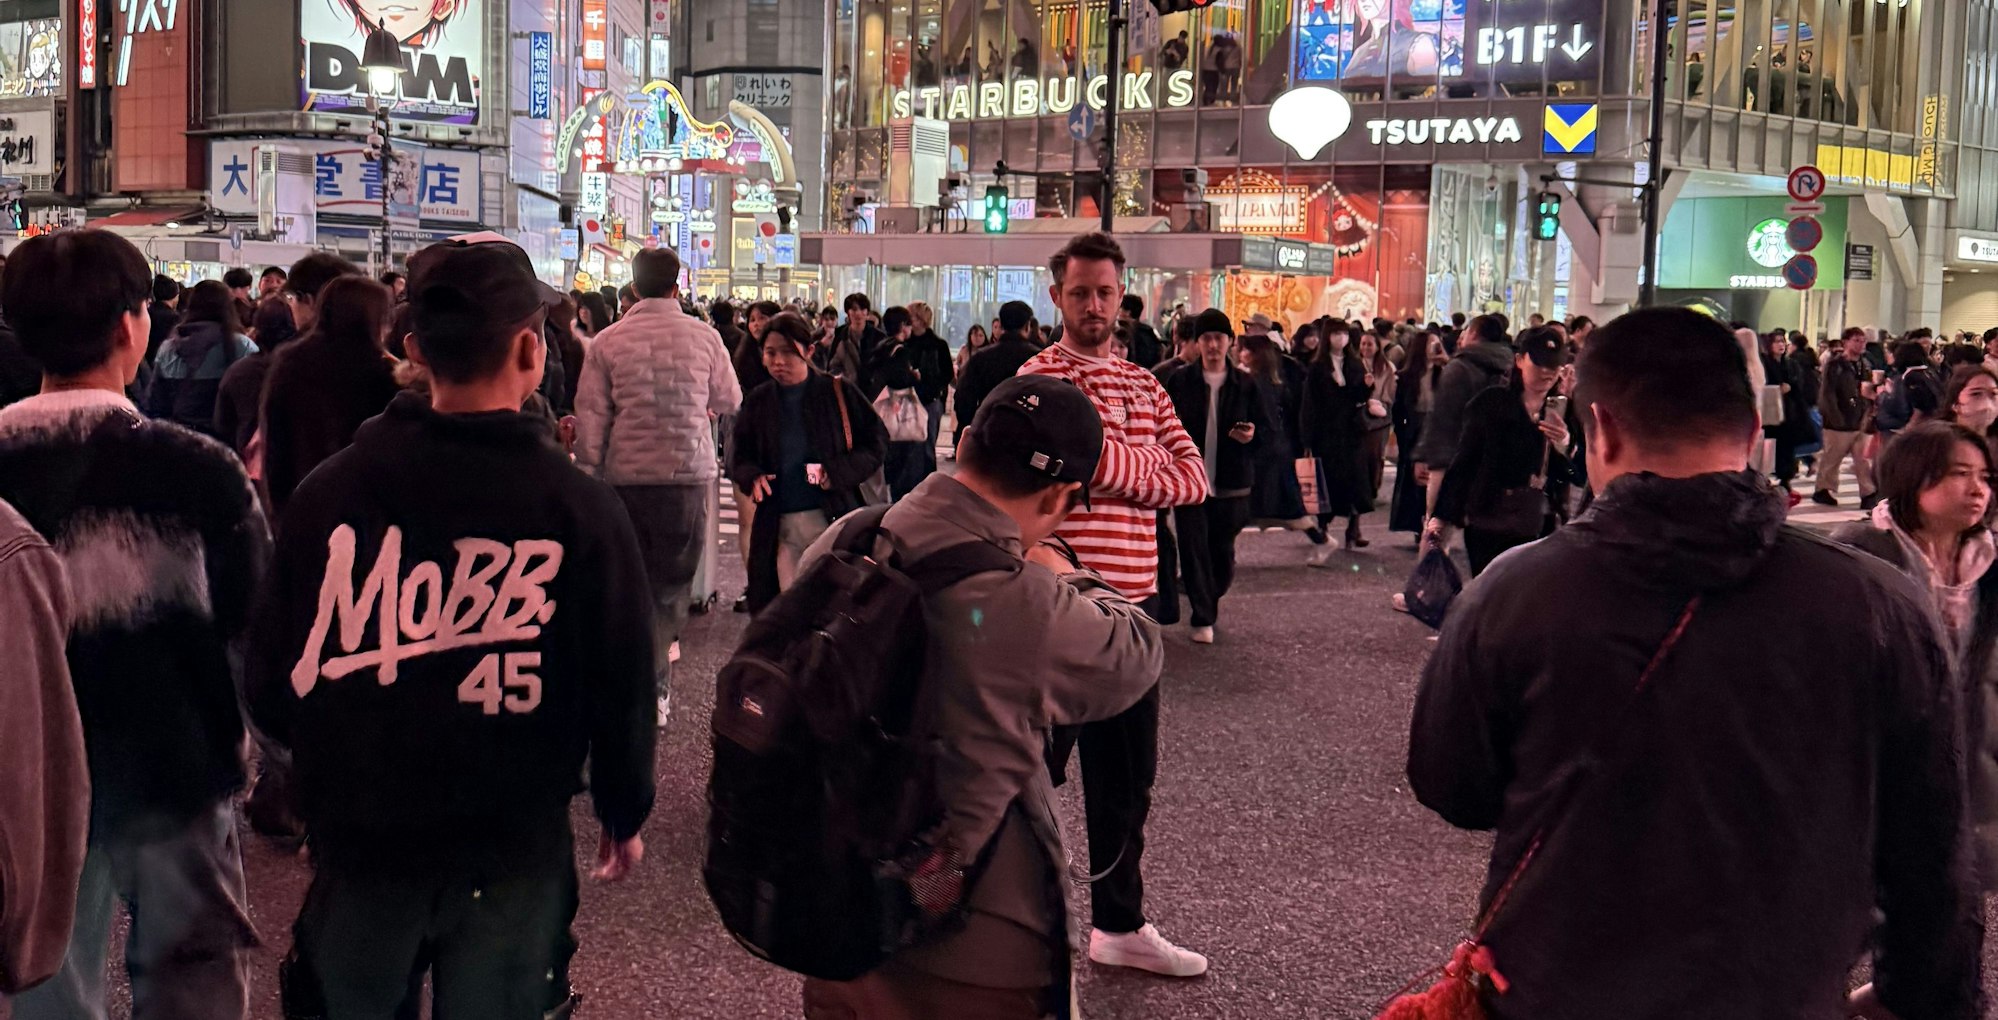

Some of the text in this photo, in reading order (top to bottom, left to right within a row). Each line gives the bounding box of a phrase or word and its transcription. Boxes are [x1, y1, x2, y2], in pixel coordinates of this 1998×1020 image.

[1477, 25, 1557, 64] B1F
[533, 37, 548, 116] 大盛堂商事ビル
[750, 77, 791, 91] れいわ
[737, 93, 790, 106] クリニック
[893, 70, 1193, 120] STARBUCKS
[1366, 117, 1521, 145] TSUTAYA
[391, 231, 432, 239] AISEIDO
[458, 652, 541, 715] 45
